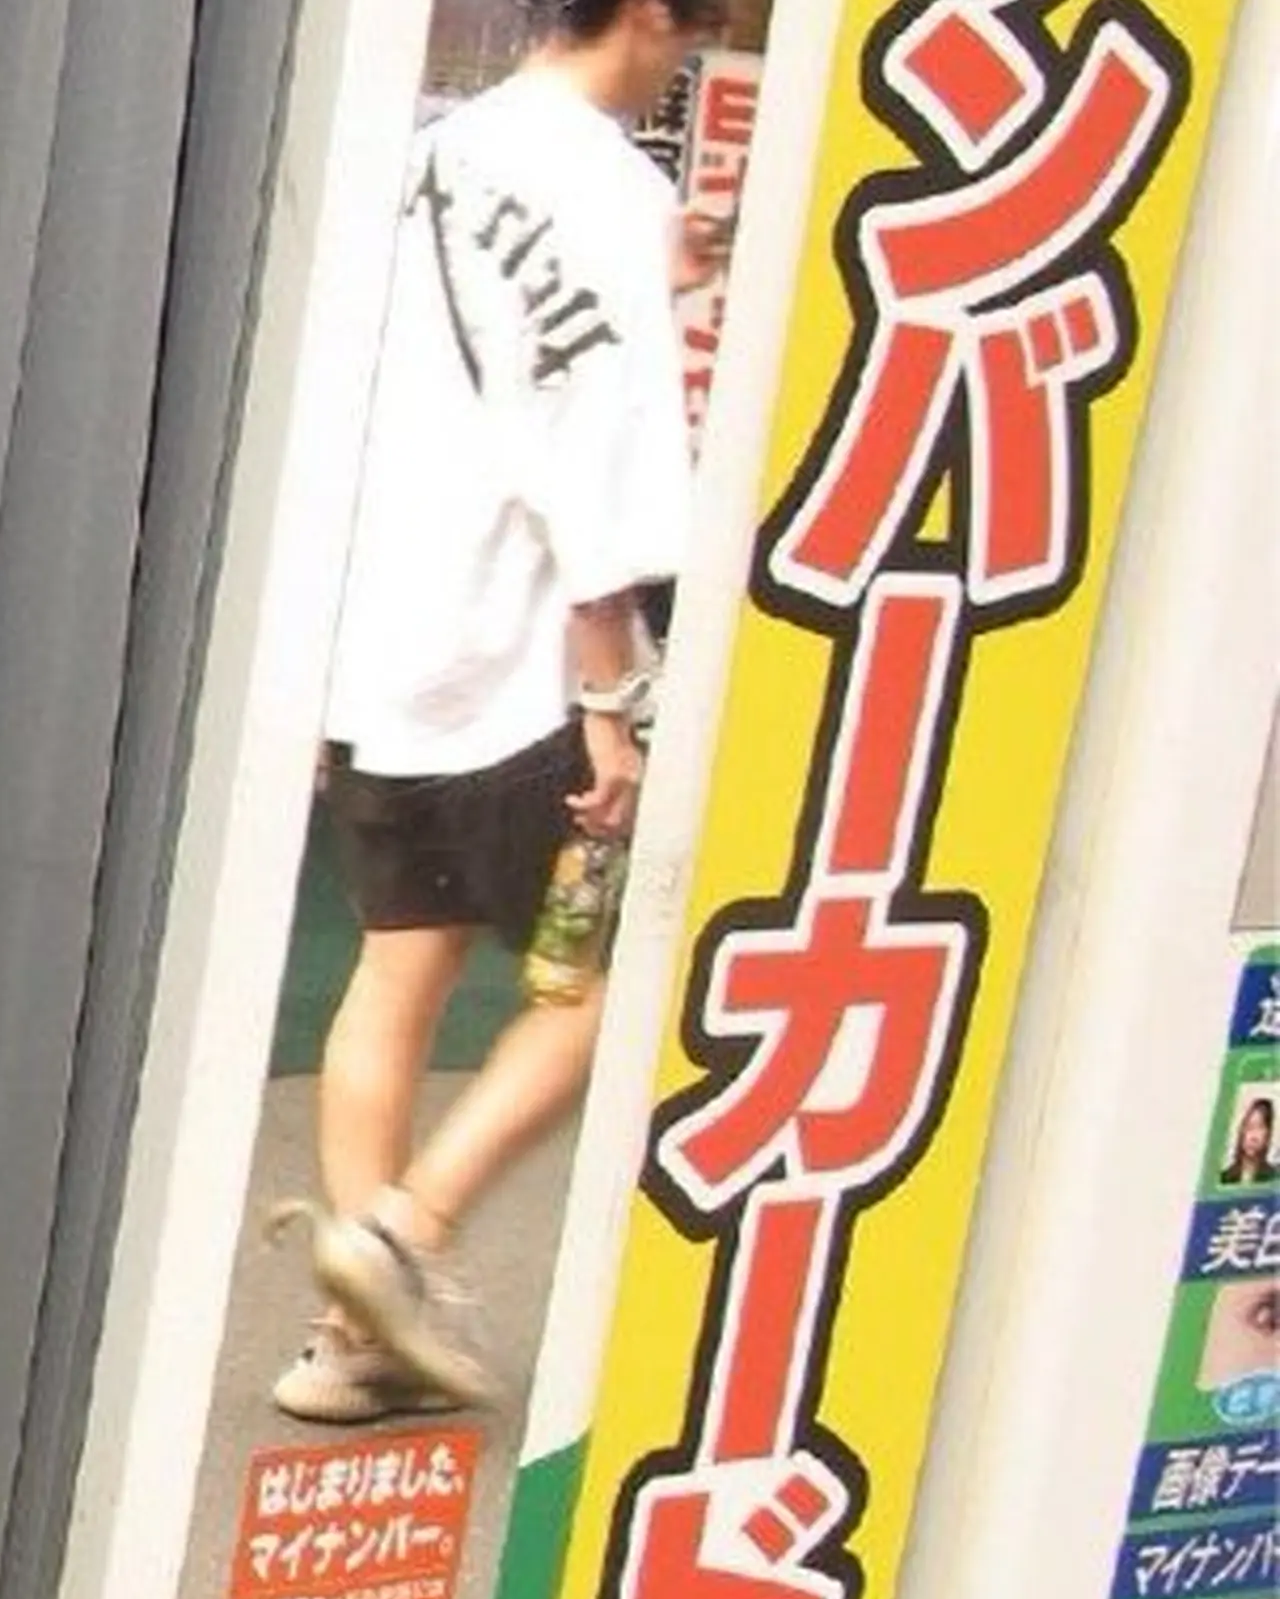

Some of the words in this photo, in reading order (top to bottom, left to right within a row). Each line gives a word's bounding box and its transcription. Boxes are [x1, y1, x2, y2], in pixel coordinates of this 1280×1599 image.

[249, 1512, 455, 1581] マイナンバー。
